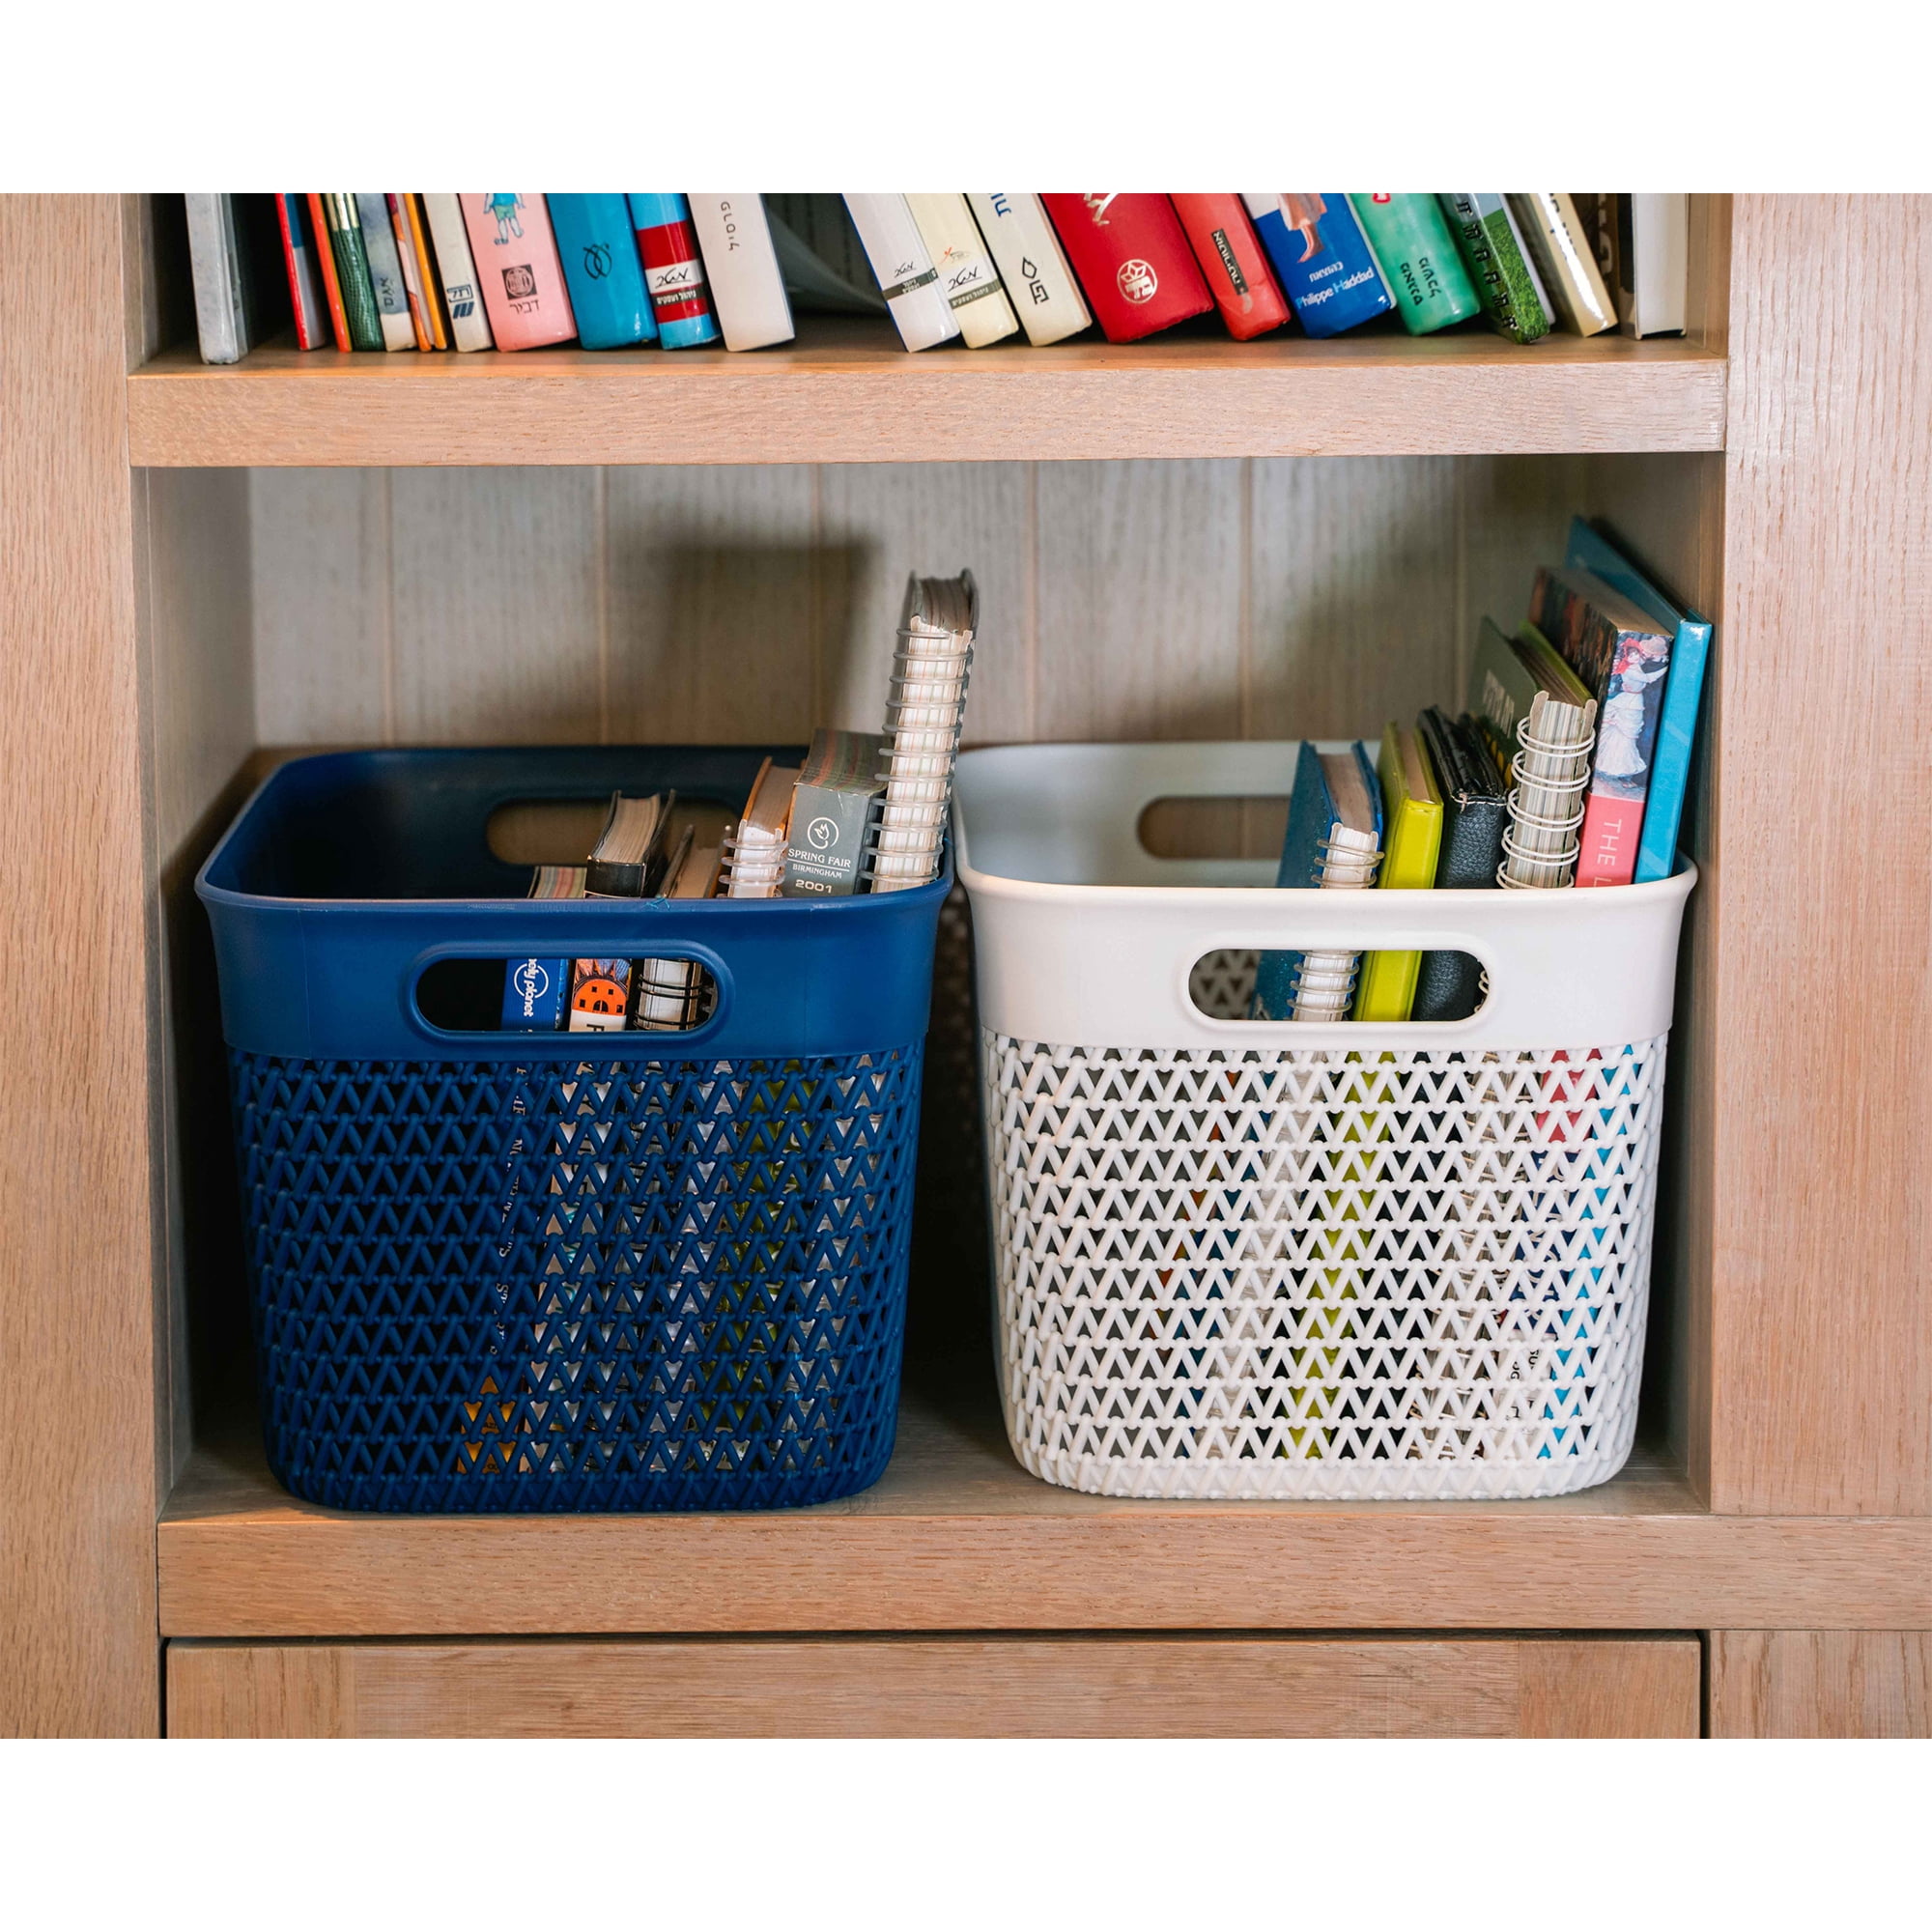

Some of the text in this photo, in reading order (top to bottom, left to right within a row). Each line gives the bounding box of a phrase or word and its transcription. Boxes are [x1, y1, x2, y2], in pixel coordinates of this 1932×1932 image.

[1295, 266, 1376, 309] Philippe Haddad
[509, 298, 540, 314] דביר
[1597, 819, 1622, 866] THE
[787, 848, 851, 868] SPRING FAIR
[792, 863, 842, 879] BIRMINGHAM
[795, 879, 833, 894] 2001
[524, 980, 537, 1017] planet
